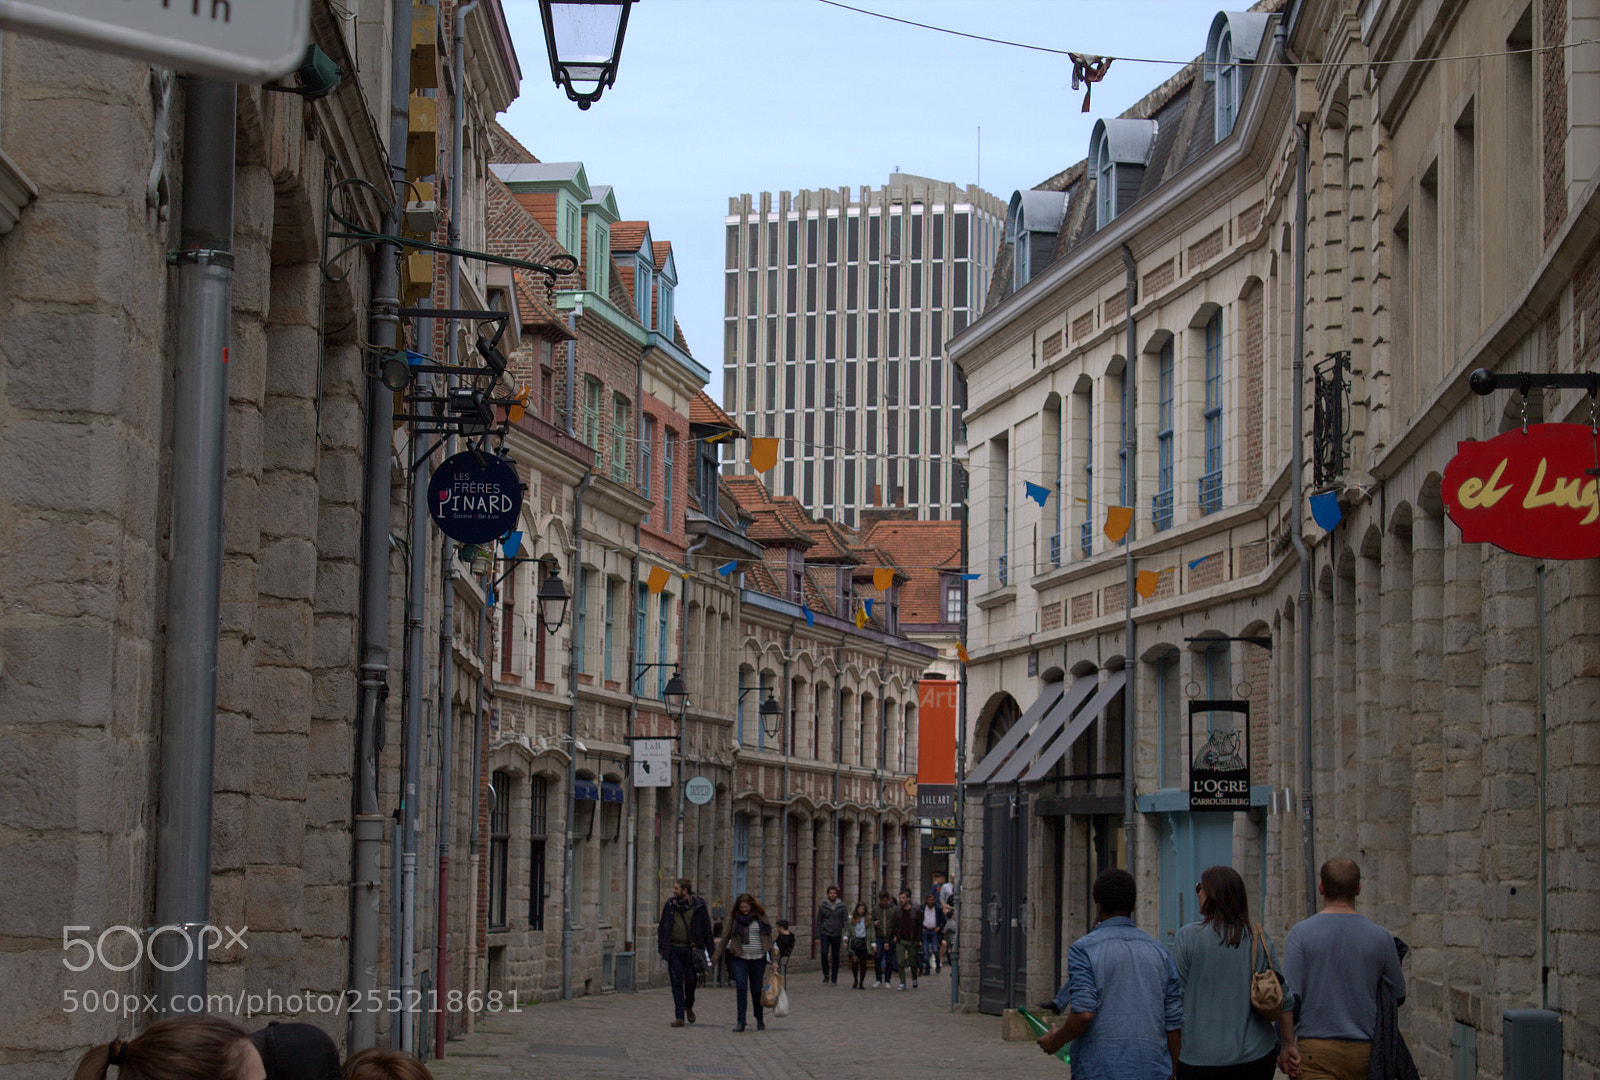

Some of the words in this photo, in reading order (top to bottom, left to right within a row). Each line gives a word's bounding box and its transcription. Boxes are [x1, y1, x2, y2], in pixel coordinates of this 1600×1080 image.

[453, 473, 470, 481] LES
[1458, 458, 1514, 510] el
[454, 481, 501, 494] FRÈRES
[437, 488, 513, 519] PINARD
[920, 687, 957, 709] Art
[1193, 779, 1248, 793] L'OGRE
[1215, 790, 1224, 798] de
